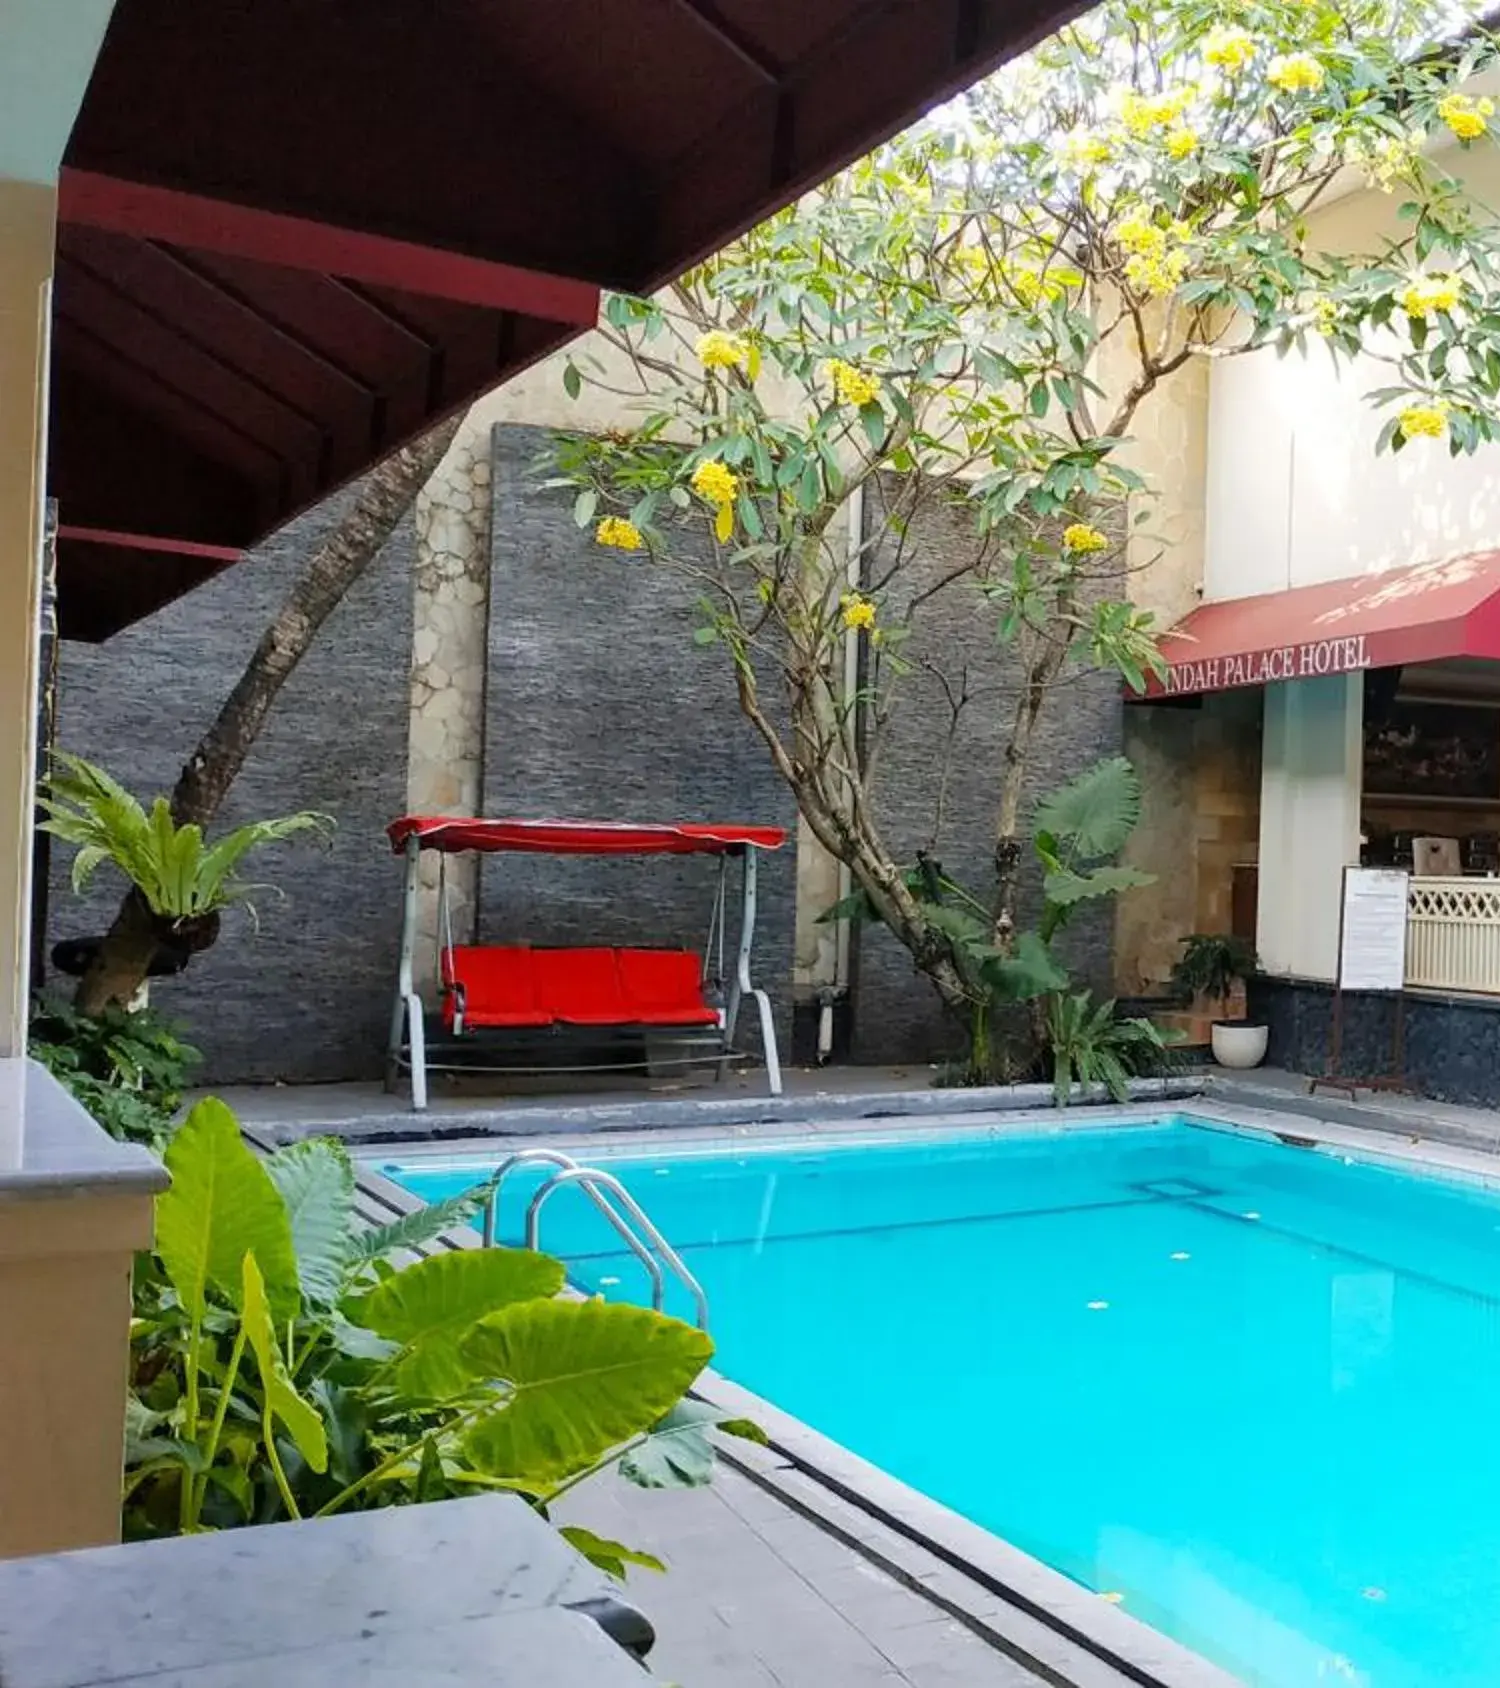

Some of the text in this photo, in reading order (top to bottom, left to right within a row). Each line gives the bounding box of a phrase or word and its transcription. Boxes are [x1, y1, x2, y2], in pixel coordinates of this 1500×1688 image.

[1165, 635, 1371, 696] INDAH PALACE HOTEL
